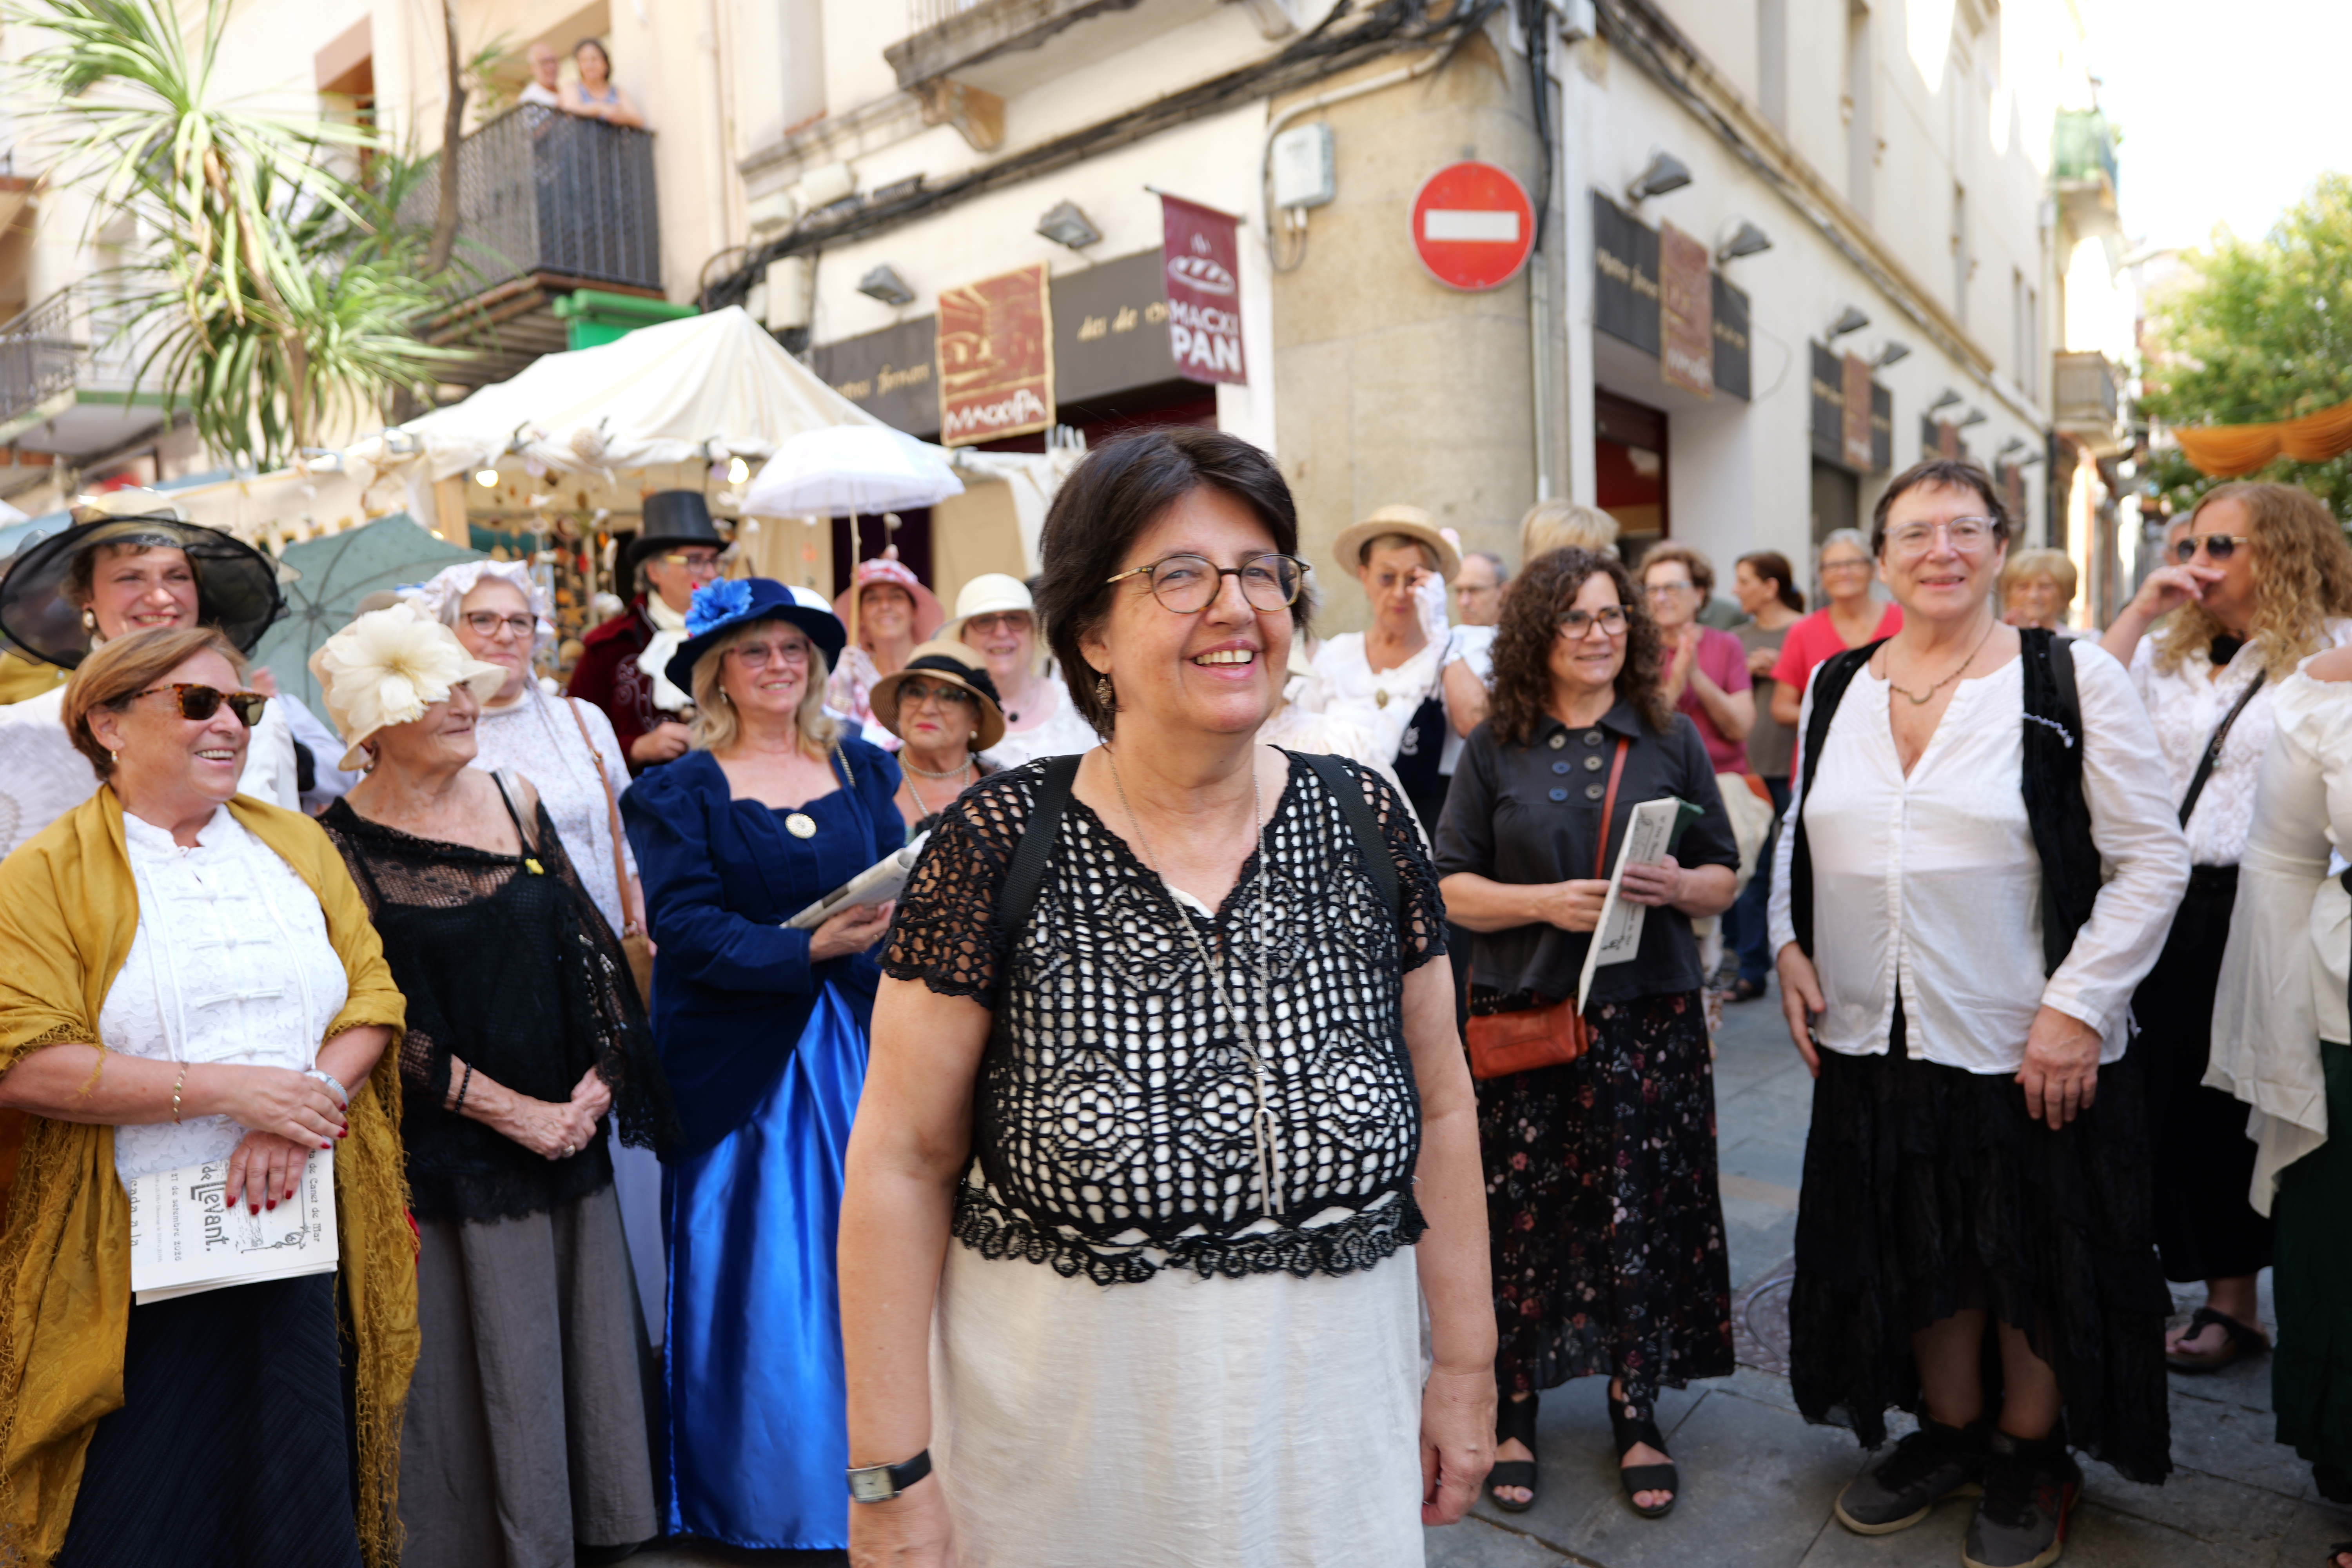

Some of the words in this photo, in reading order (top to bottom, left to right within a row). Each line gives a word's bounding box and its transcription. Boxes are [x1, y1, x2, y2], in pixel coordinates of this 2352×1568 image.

[1169, 298, 1238, 336] MACXI
[1171, 324, 1241, 374] PAN
[309, 1163, 317, 1173] de
[171, 1172, 178, 1181] 27
[172, 1185, 179, 1195] de
[310, 1178, 318, 1202] Canet
[312, 1207, 319, 1218] de
[313, 1222, 321, 1241] Mar
